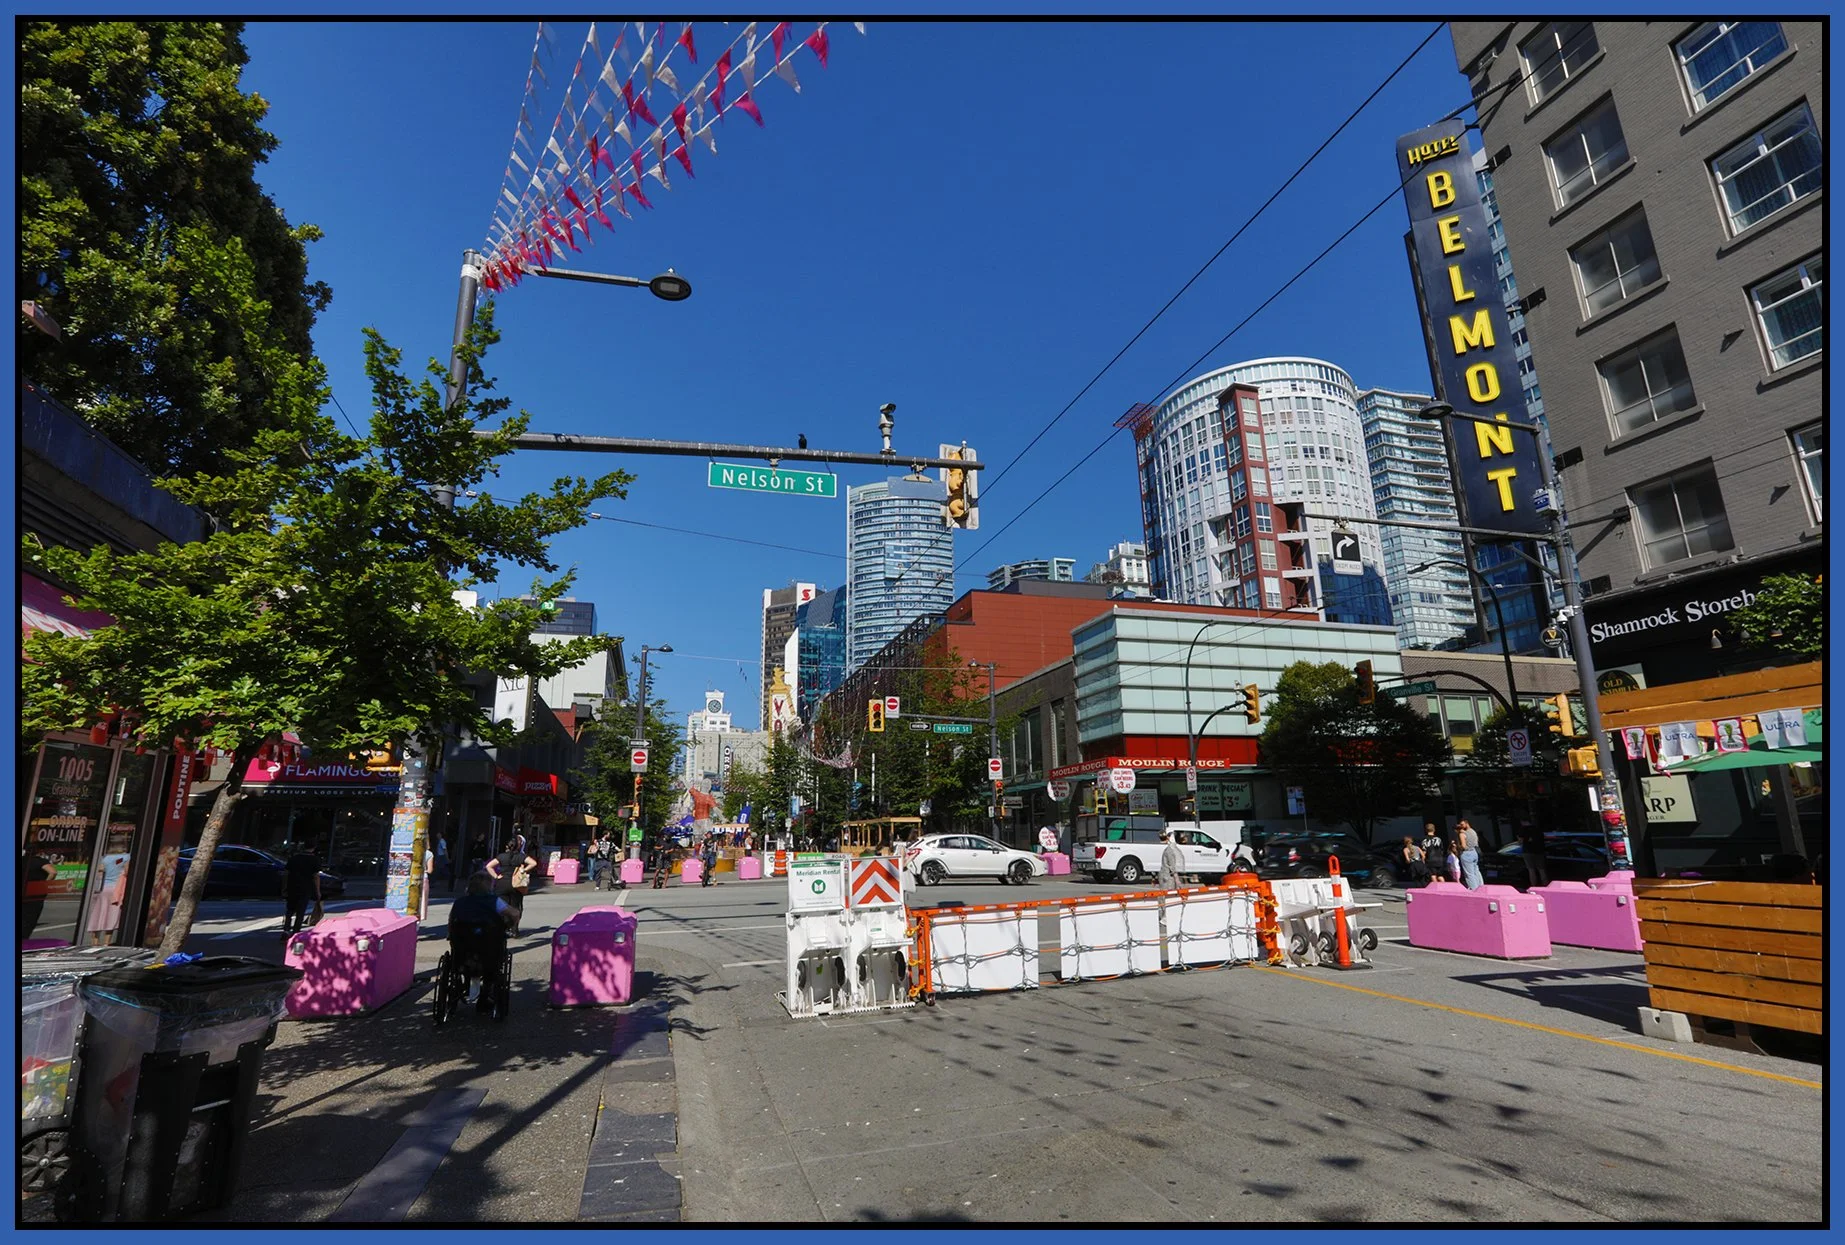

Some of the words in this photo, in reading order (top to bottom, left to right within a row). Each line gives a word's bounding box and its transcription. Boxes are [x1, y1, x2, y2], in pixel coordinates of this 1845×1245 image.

[1408, 135, 1459, 166] HOTEL
[1426, 169, 1518, 512] BELMONT
[722, 468, 794, 491] Nelson
[806, 476, 824, 493] St
[1590, 608, 1681, 643] Shamrock
[1685, 589, 1756, 623] Storeh
[1390, 685, 1421, 697] Granville
[1425, 683, 1434, 692] St
[1603, 679, 1623, 688] OLD
[1765, 720, 1800, 731] ULTRA
[1665, 733, 1695, 741] ULTRA
[59, 756, 95, 781] 1005
[1052, 766, 1079, 777] MOULIN
[1081, 760, 1106, 771] ROUGE
[1118, 759, 1175, 767] MOULIN
[172, 755, 190, 819] POUTINE
[50, 815, 88, 829] ORDER
[38, 828, 85, 842] ON-LINE
